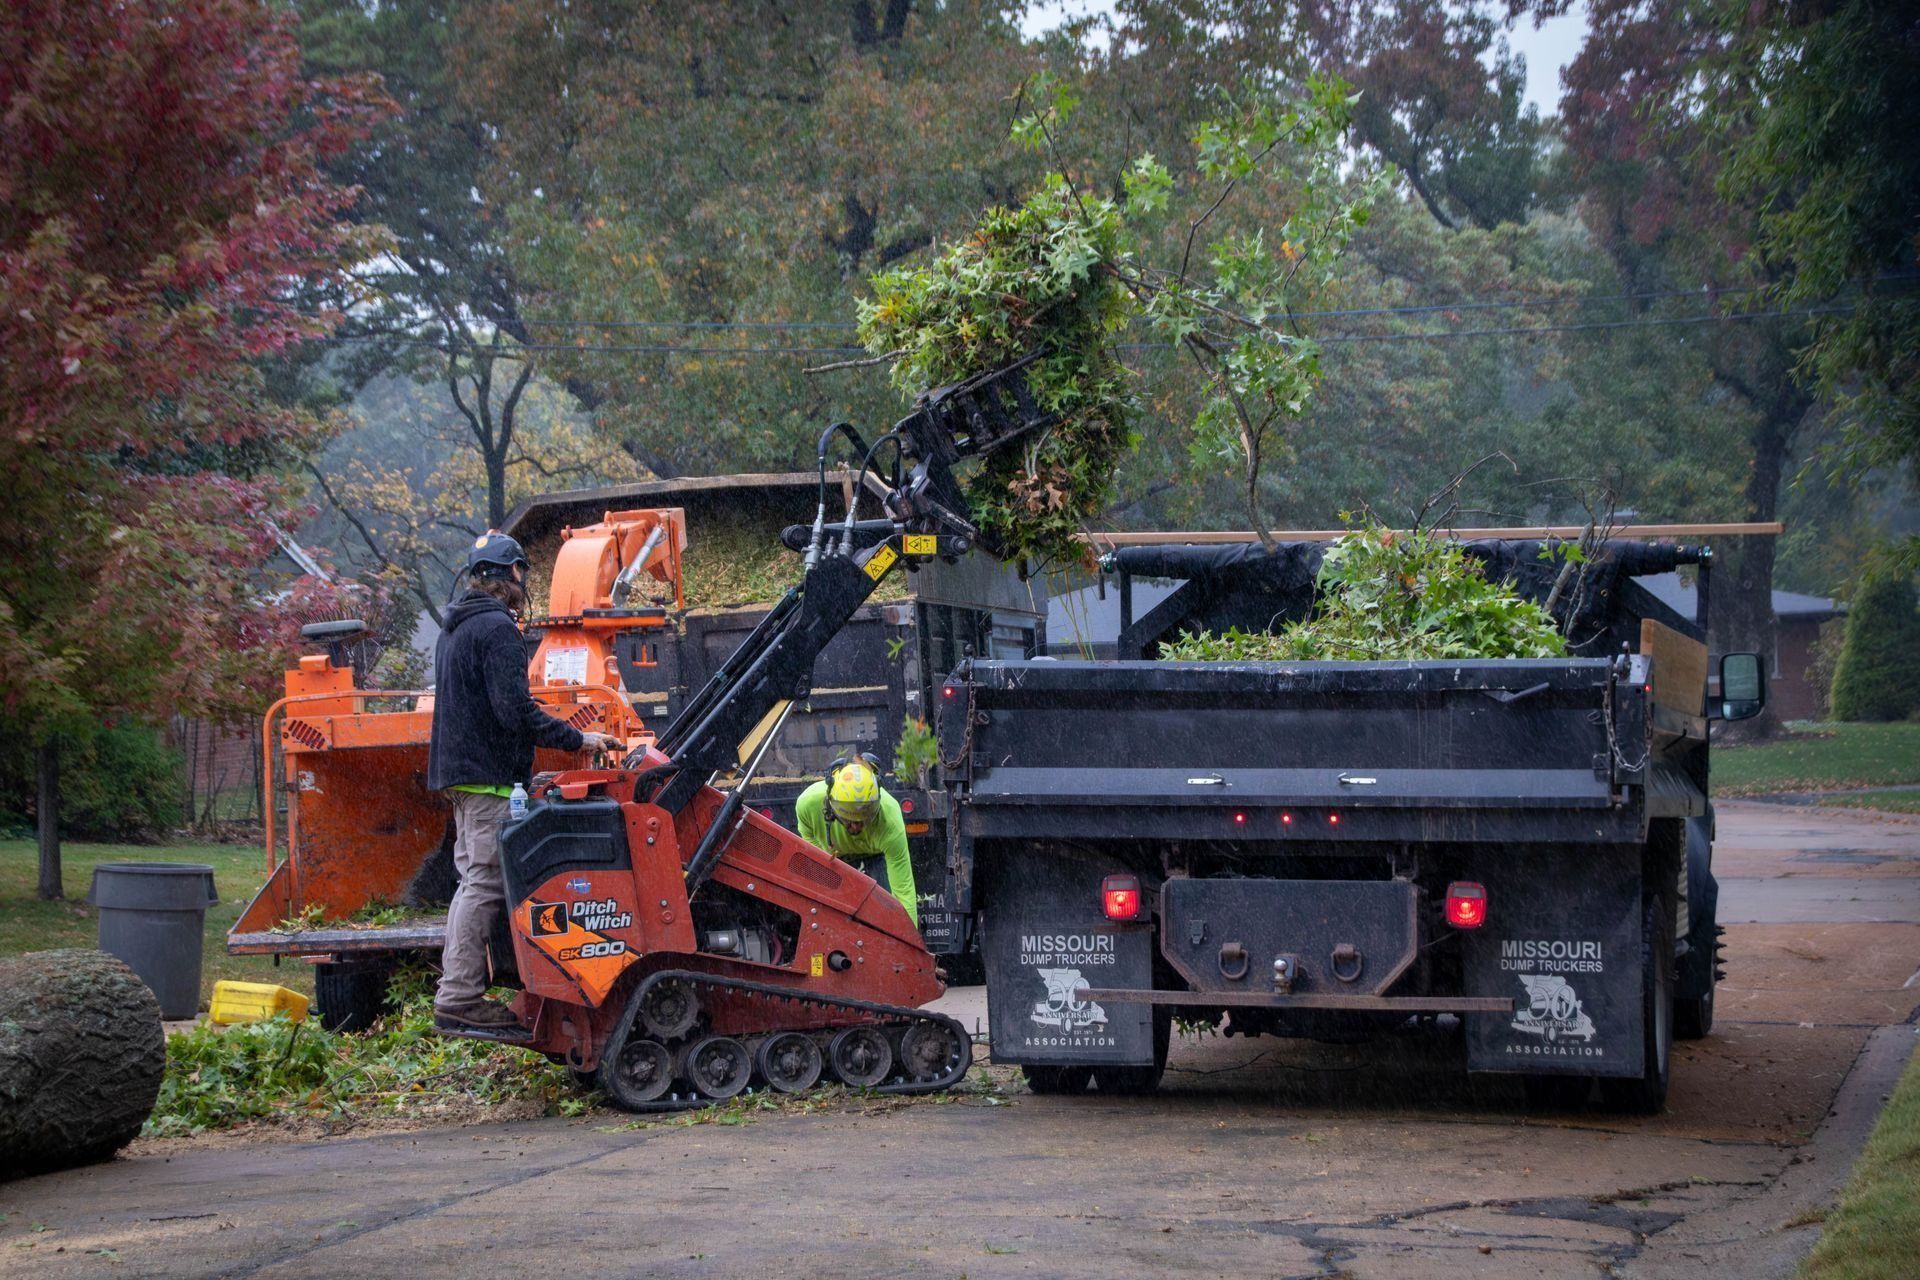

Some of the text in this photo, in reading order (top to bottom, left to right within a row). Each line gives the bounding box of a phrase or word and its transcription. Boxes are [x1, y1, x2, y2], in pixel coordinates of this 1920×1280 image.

[573, 899, 616, 916] Ditch
[585, 913, 631, 930] Witch
[926, 928, 951, 936] SONS
[560, 941, 625, 959] SK800
[1022, 935, 1114, 952] MISSOURI
[1501, 940, 1602, 959] MISSOURI
[1021, 954, 1115, 964] DUMP TRUCKERS
[1501, 959, 1603, 972] DUMP TRUCKERS
[1025, 1038, 1115, 1046] ASSOCIATION
[1506, 1045, 1603, 1056] ASSOCIATION
